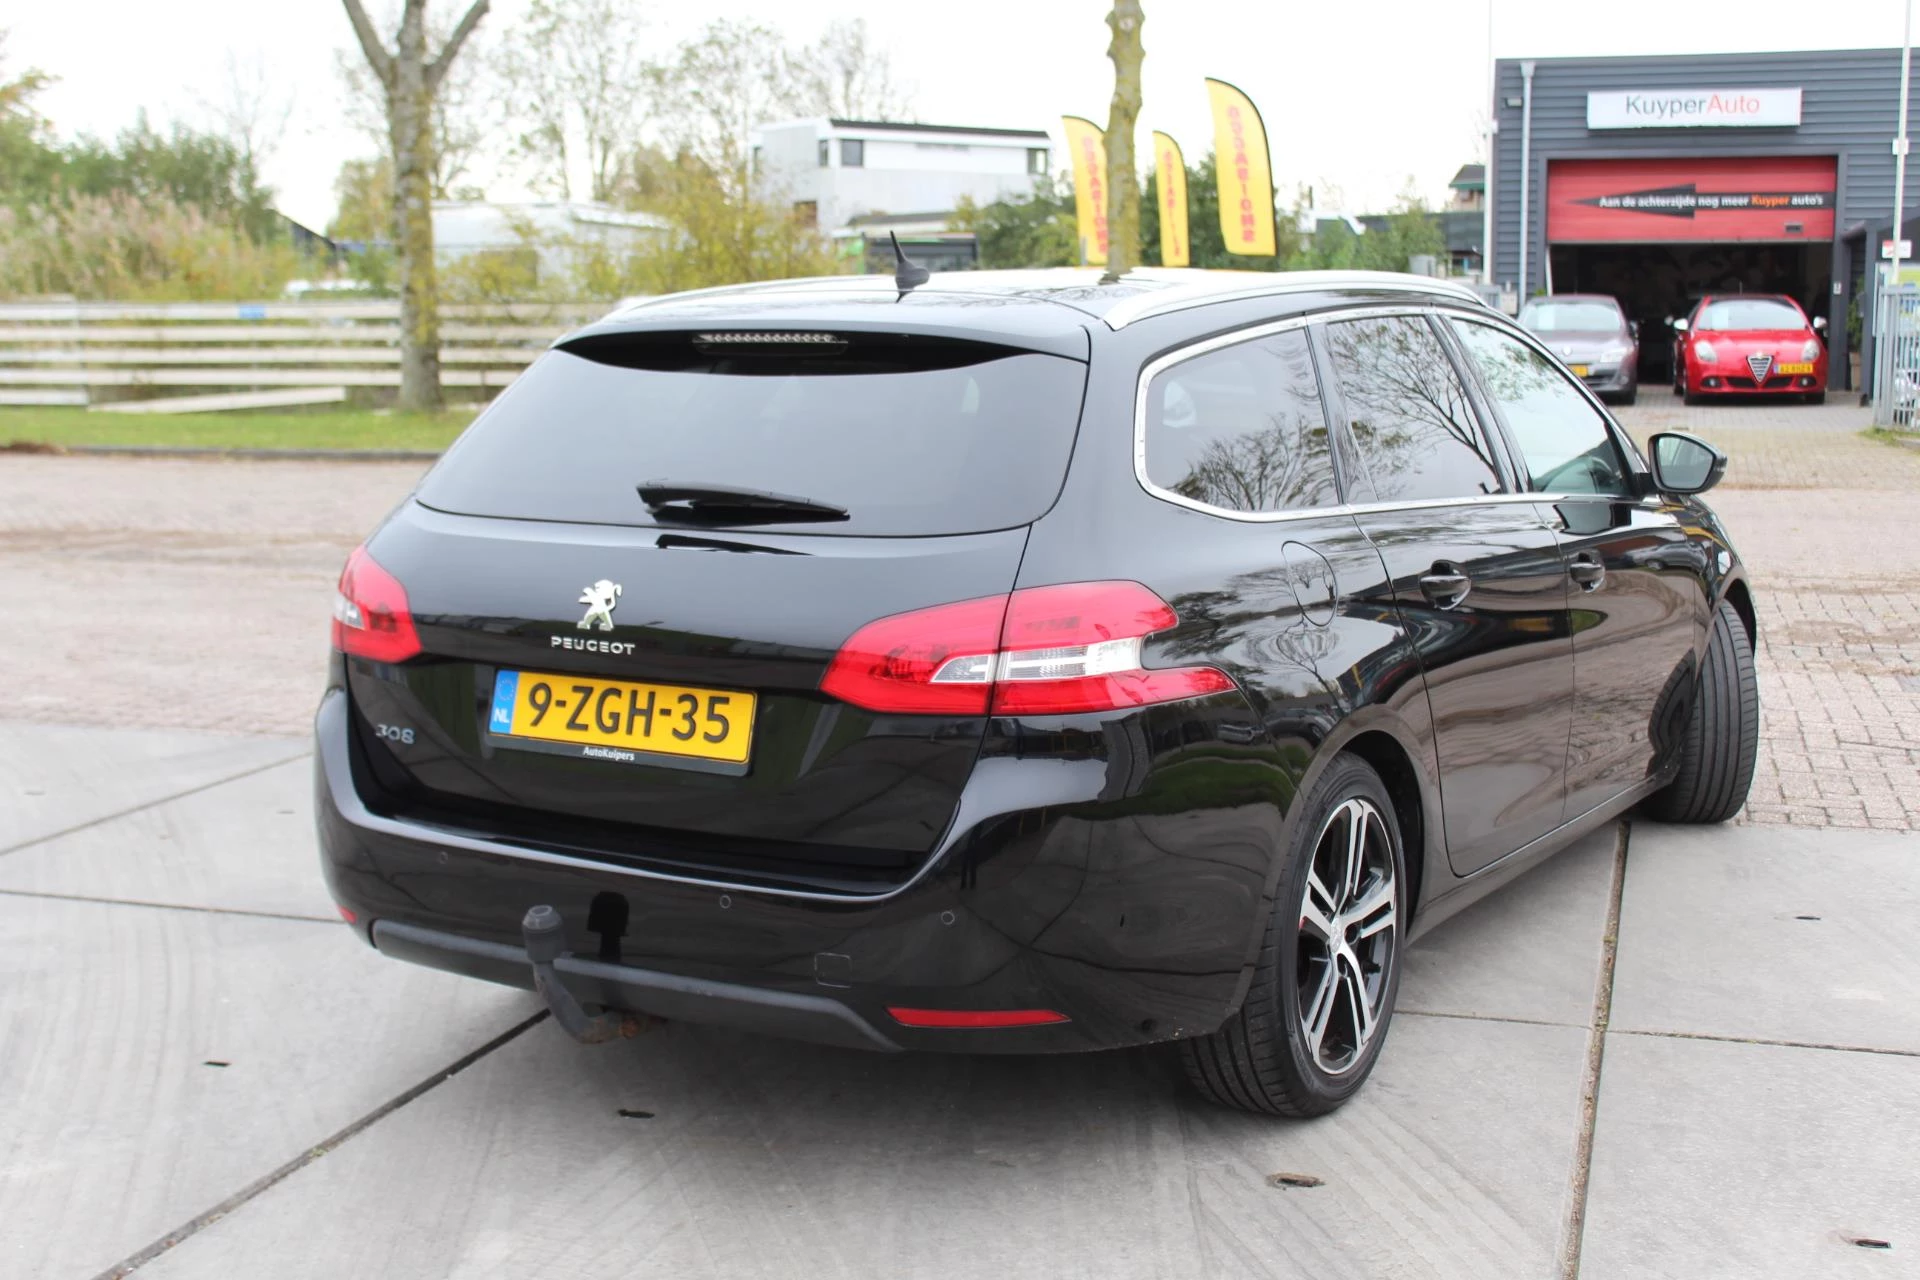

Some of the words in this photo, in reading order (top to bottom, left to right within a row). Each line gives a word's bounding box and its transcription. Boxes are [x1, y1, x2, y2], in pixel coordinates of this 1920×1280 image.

[1626, 92, 1760, 119] KuyperAuto
[1600, 195, 1620, 208] Aan
[1622, 195, 1636, 207] de
[1638, 194, 1696, 209] achterzijde
[1698, 195, 1719, 208] nog
[1721, 195, 1749, 206] meer
[1751, 194, 1789, 207] Kuyper
[1791, 193, 1824, 206] auto's
[551, 635, 636, 655] PEUGEOT
[493, 708, 510, 724] NL
[528, 682, 730, 743] 9-ZGH-35
[375, 724, 415, 745] 308
[583, 746, 635, 761] AutoKuipers
